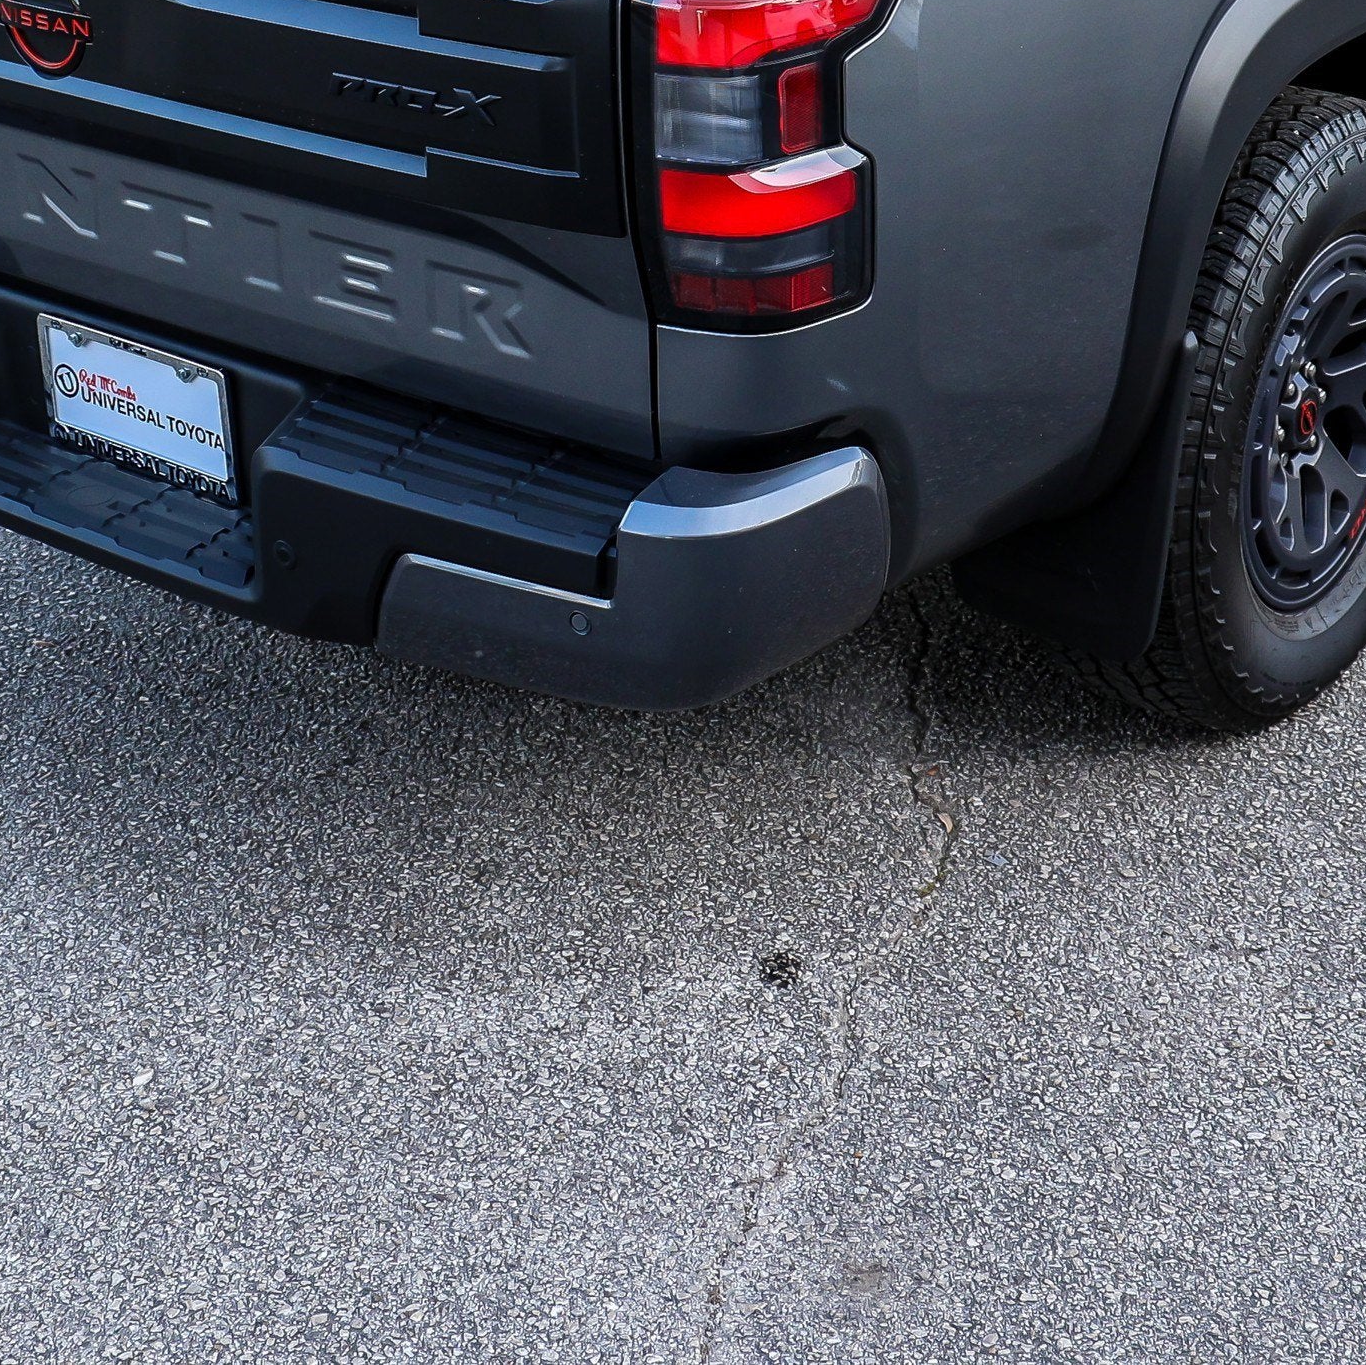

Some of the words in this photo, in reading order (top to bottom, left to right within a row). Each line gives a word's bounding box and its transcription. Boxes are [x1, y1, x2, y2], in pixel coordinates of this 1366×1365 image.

[0, 2, 90, 37] NISSAN
[331, 71, 503, 127] PRO-X
[78, 369, 97, 389] Red
[97, 376, 137, 401] McCombs
[81, 386, 166, 429] UNIVERSAL
[166, 415, 226, 451] TOYOTA
[74, 430, 167, 478] UNIVERSAL
[165, 463, 233, 502] TOYOTA
